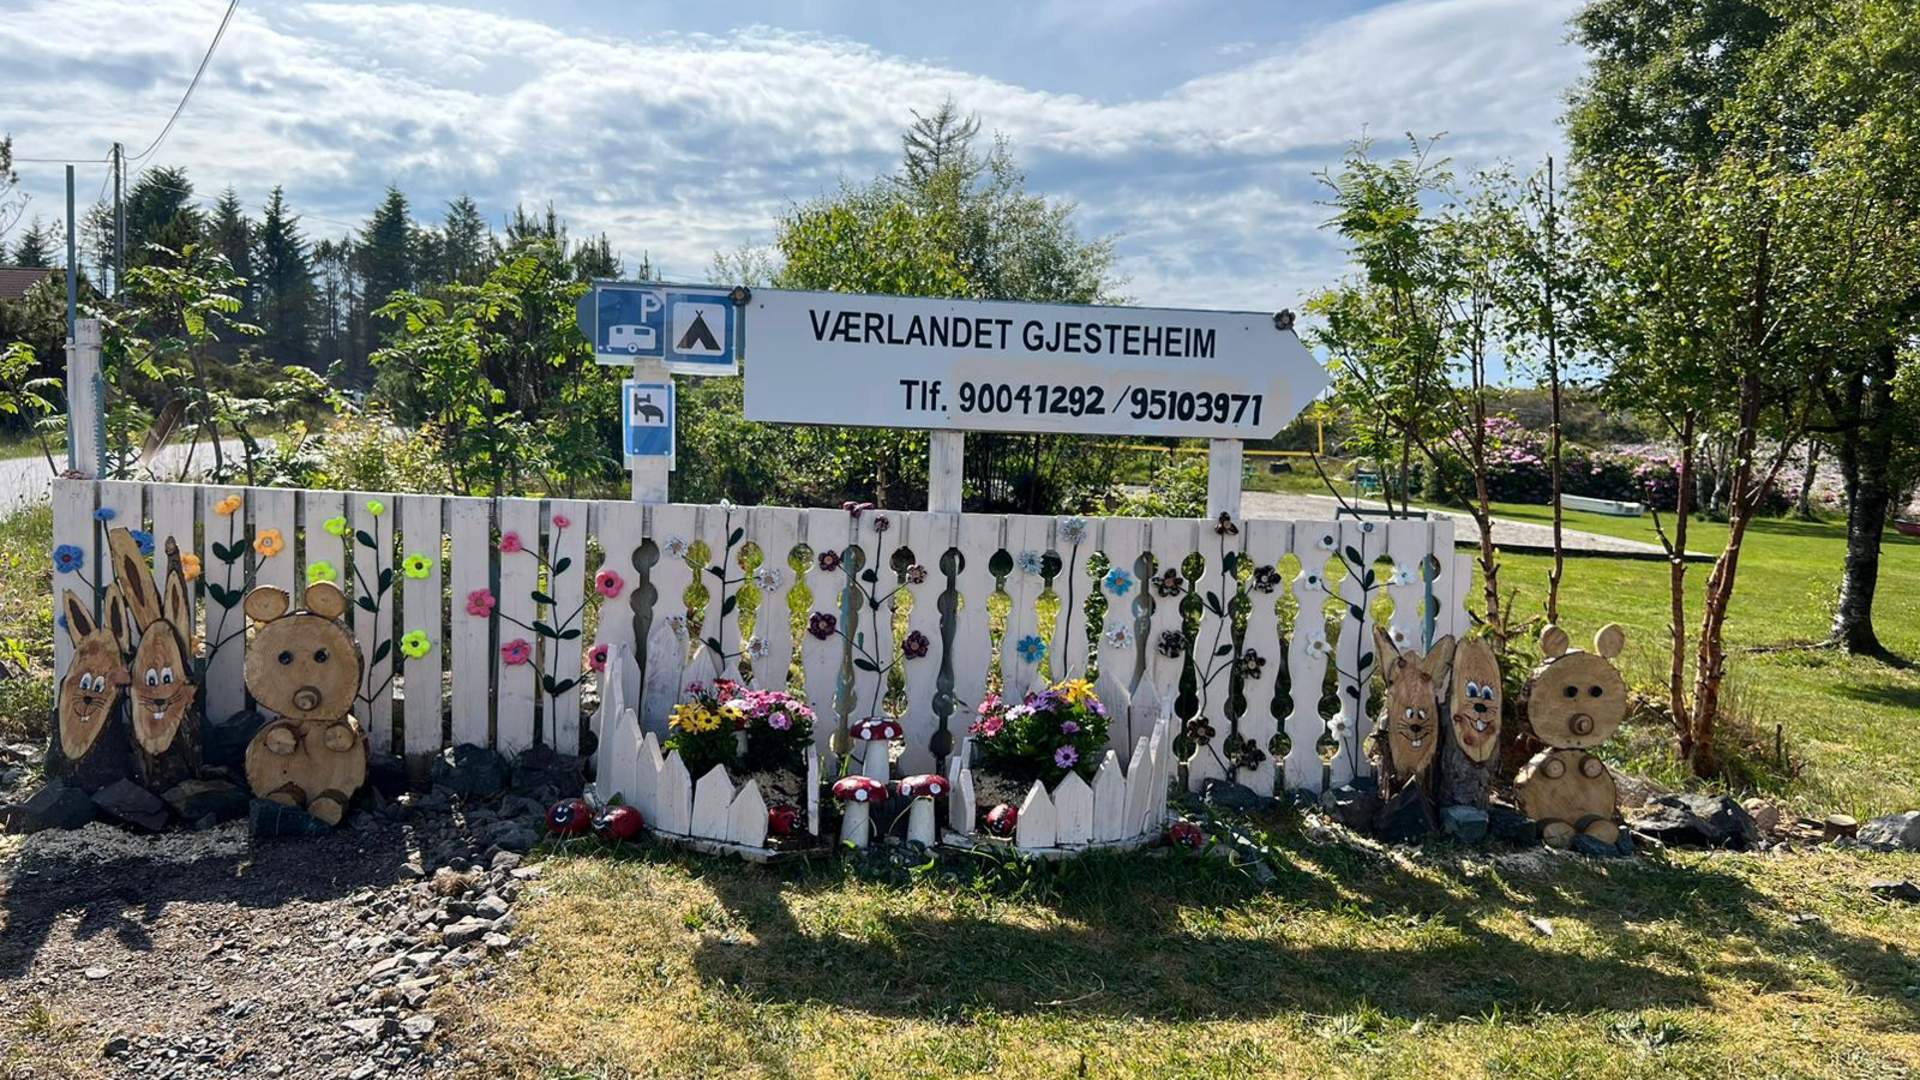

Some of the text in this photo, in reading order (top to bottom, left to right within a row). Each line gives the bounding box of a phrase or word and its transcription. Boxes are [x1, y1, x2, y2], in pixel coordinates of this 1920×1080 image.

[641, 293, 662, 323] P
[809, 309, 1216, 358] VÆRLANDET GJESTEHEIM
[900, 379, 947, 412] Tlf.
[959, 381, 1105, 417] 90041292
